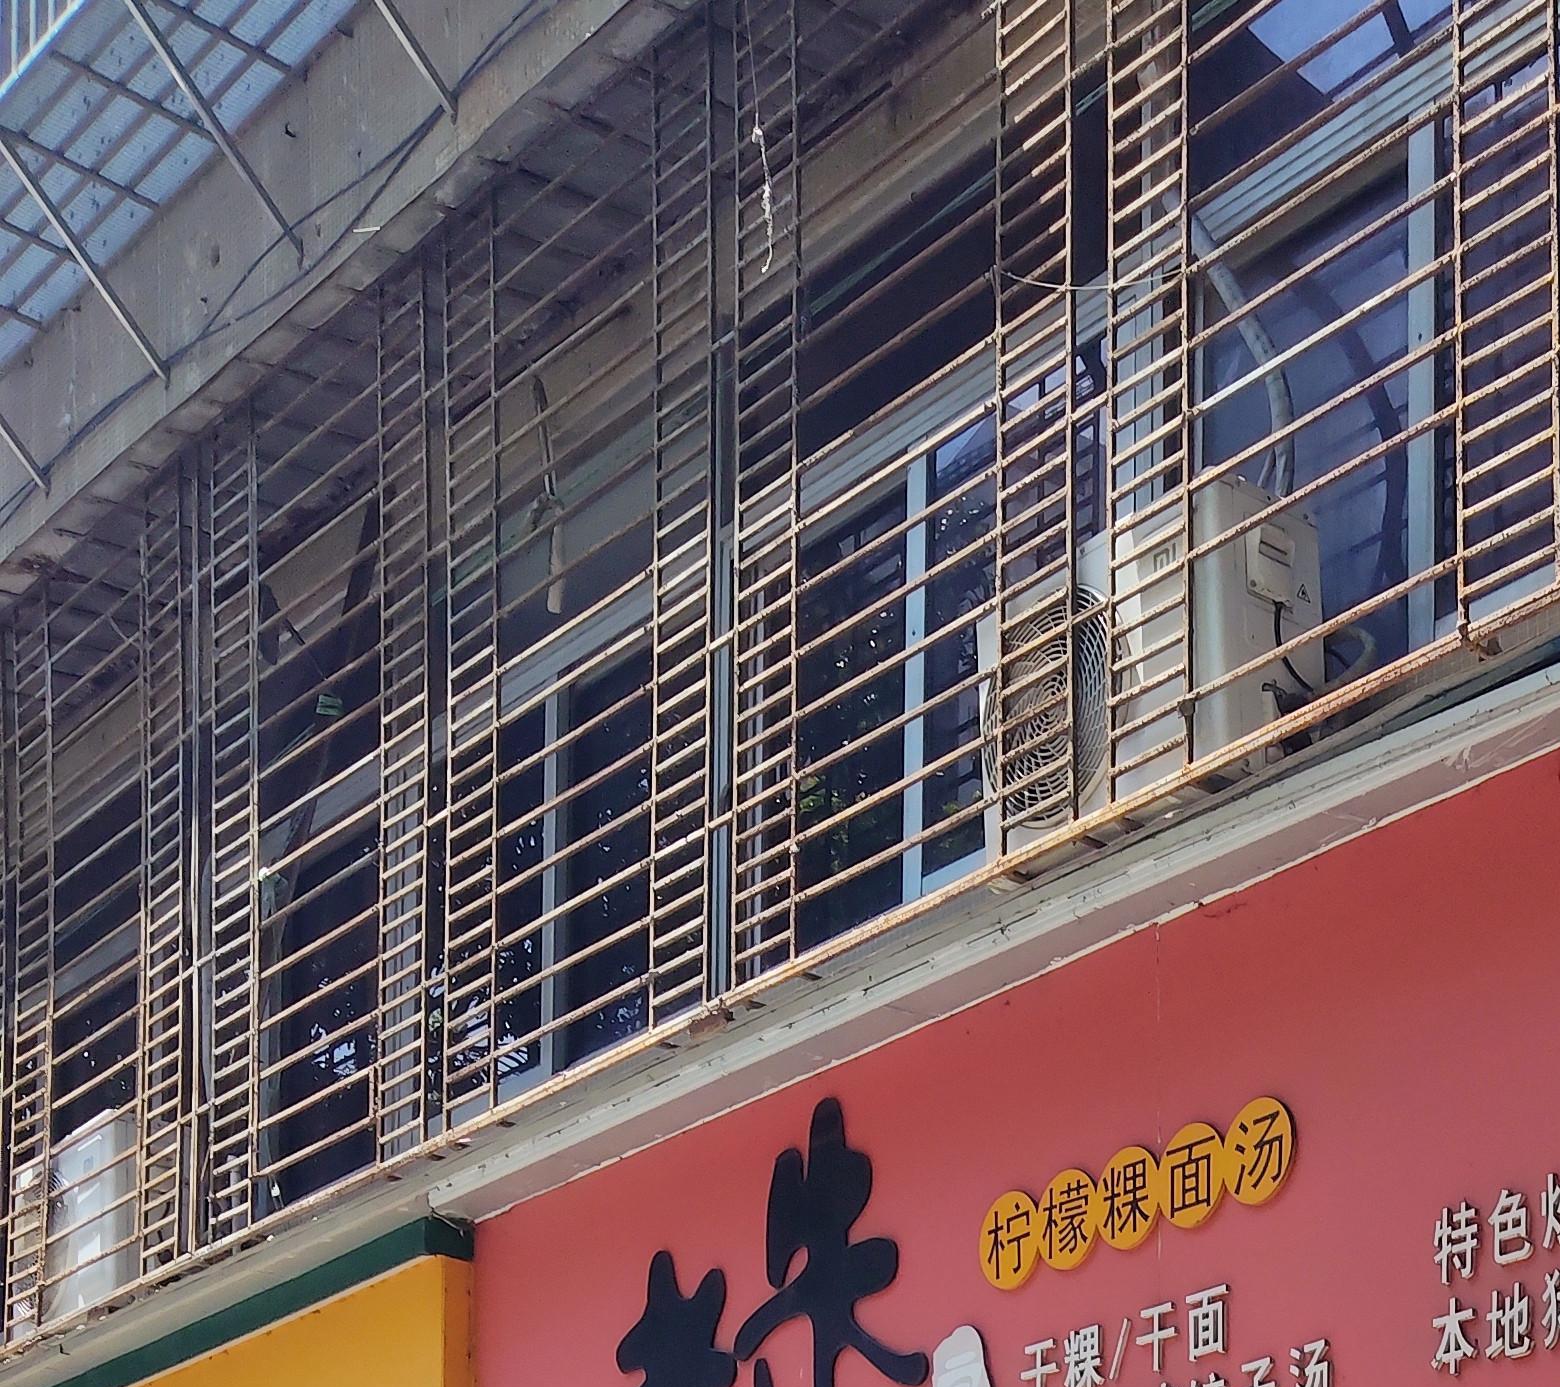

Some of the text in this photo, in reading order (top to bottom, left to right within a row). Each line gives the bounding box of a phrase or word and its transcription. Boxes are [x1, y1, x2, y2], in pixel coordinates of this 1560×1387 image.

[986, 1104, 1287, 1284] 柠檬粿面汤
